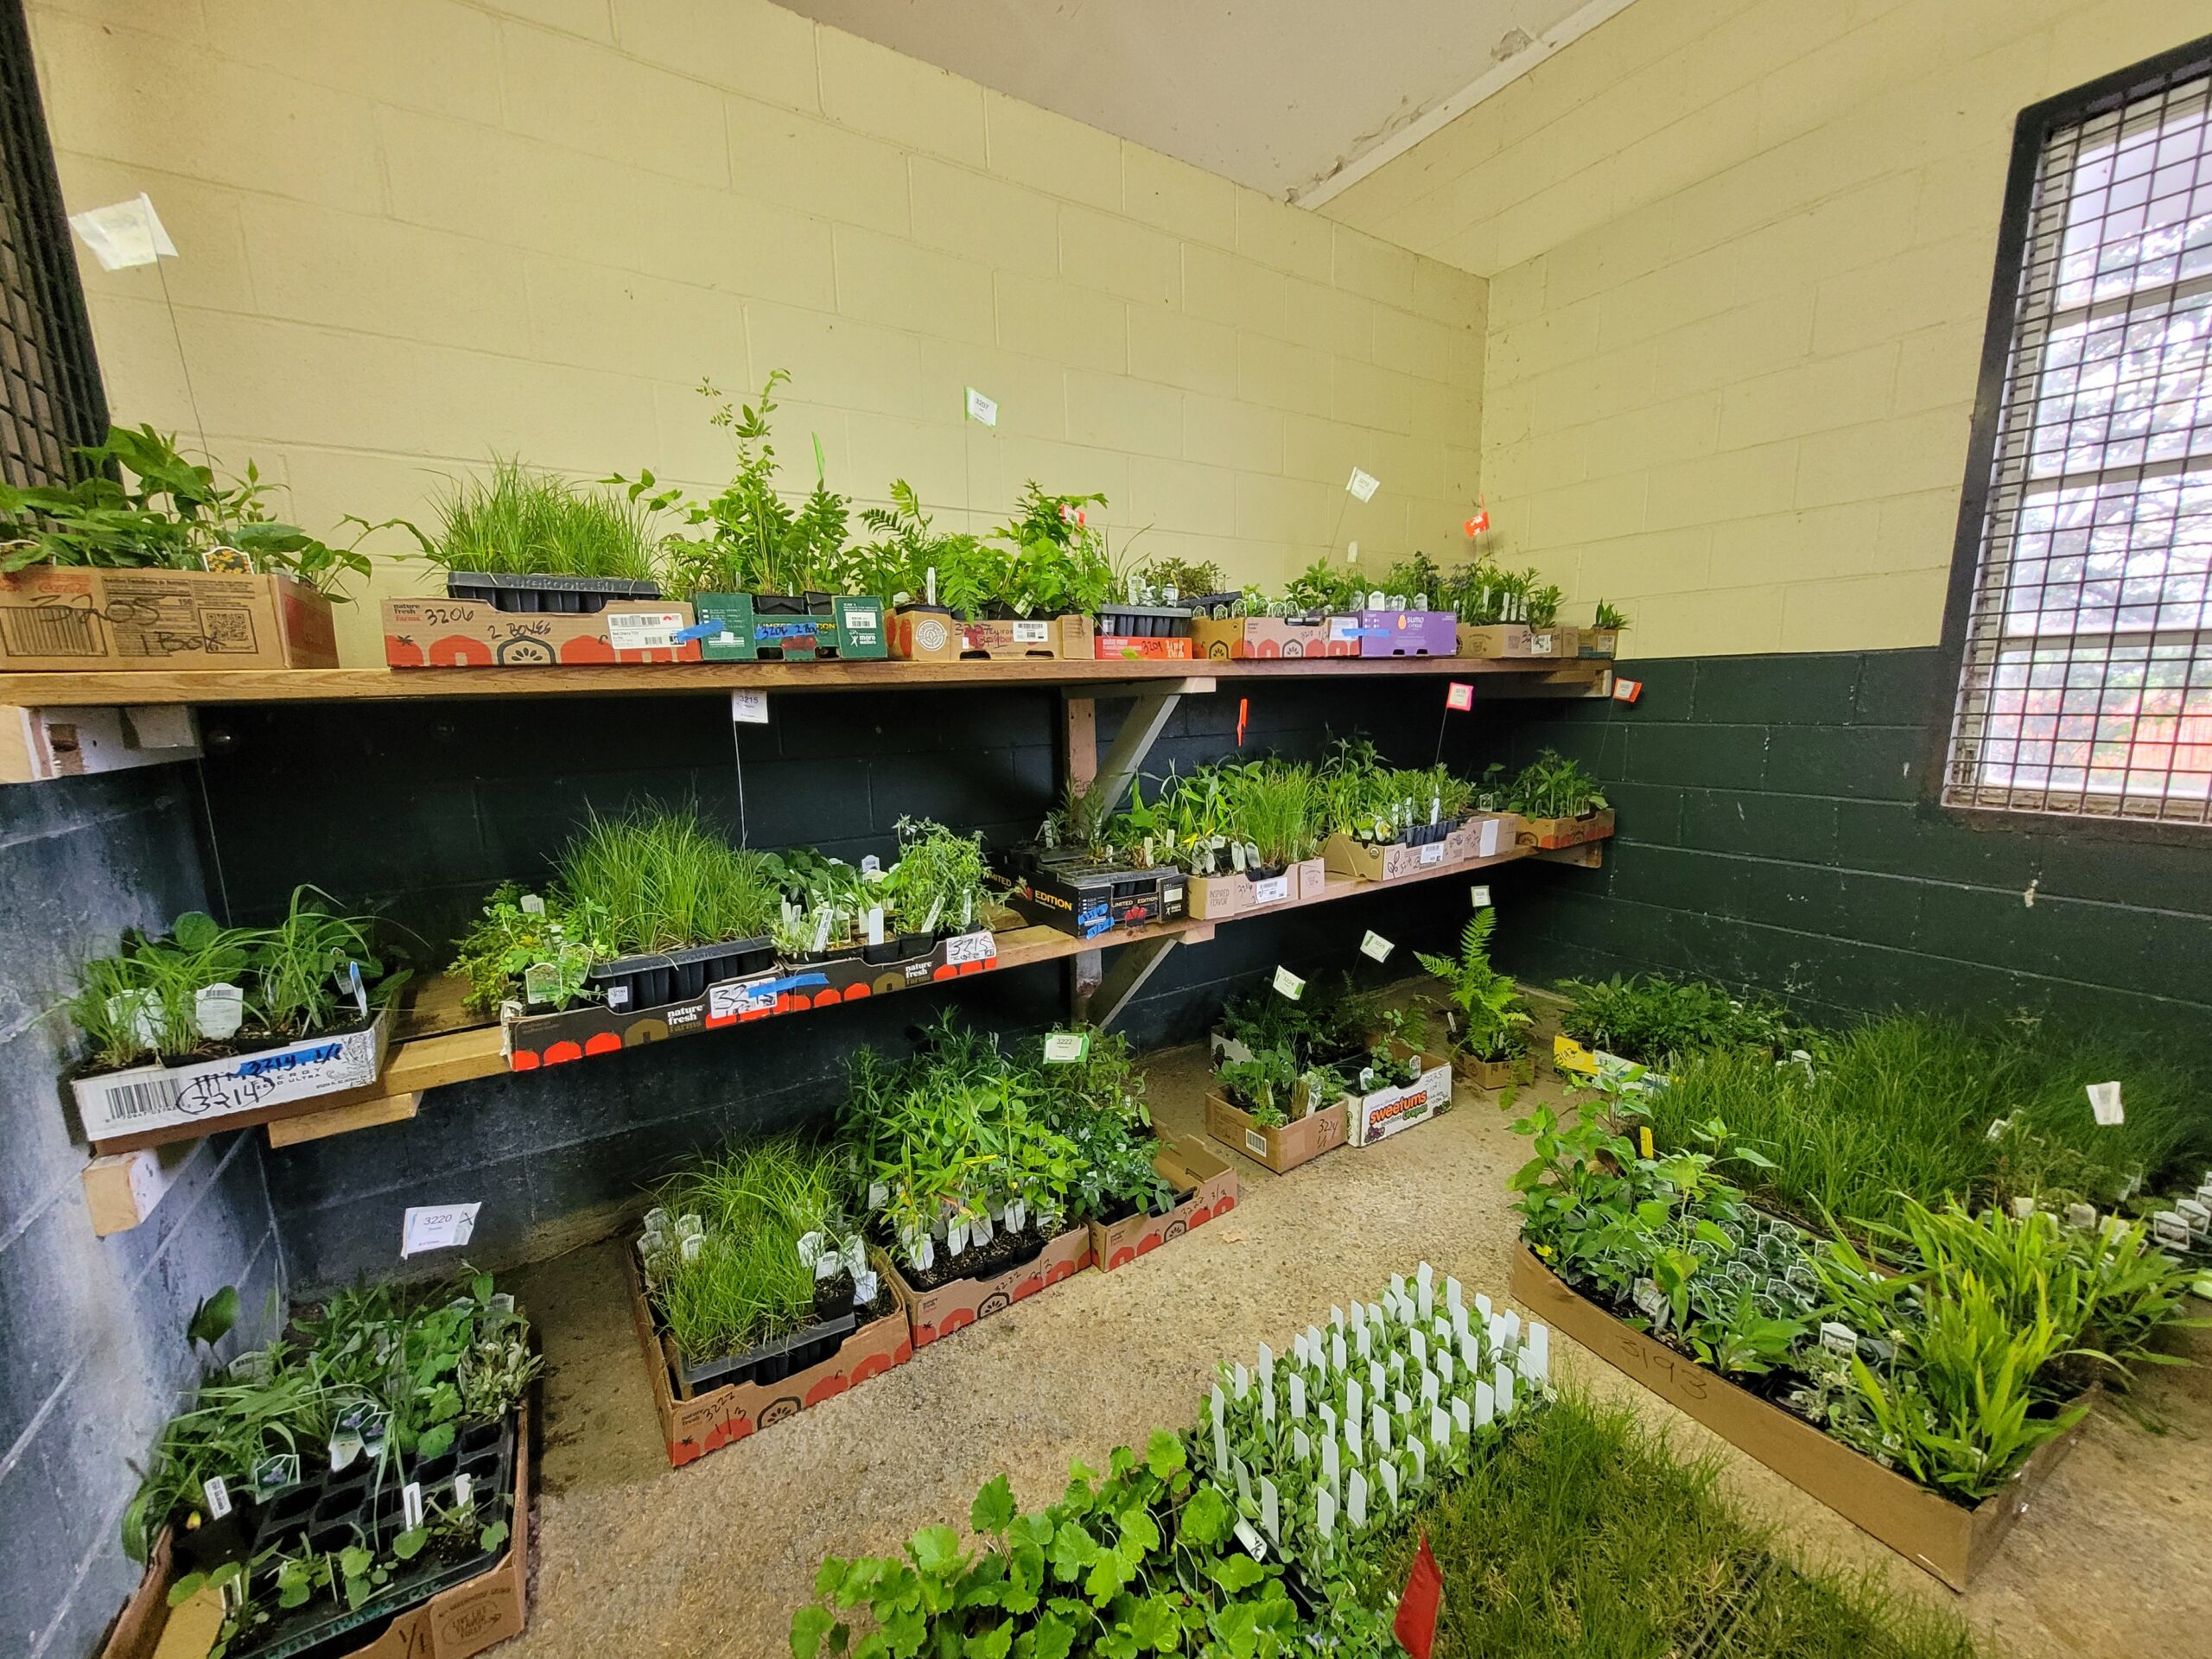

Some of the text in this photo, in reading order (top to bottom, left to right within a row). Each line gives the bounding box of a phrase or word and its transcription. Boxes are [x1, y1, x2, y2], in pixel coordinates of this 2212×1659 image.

[425, 607, 474, 626] 3206
[739, 695, 759, 704] 3215
[1034, 890, 1072, 912] EDITION
[905, 961, 932, 972] nature
[906, 969, 928, 978] fresh
[667, 1005, 703, 1018] nature
[668, 1014, 697, 1026] fresh
[289, 1073, 321, 1083] ULTRA
[192, 1080, 260, 1115] 3214
[1370, 1090, 1427, 1125] sweetums
[1319, 1118, 1338, 1140] 3224
[423, 1214, 452, 1225] 3220
[1617, 1335, 1707, 1400] 3193
[702, 1391, 735, 1421] 3222
[715, 1407, 747, 1436] 1/3
